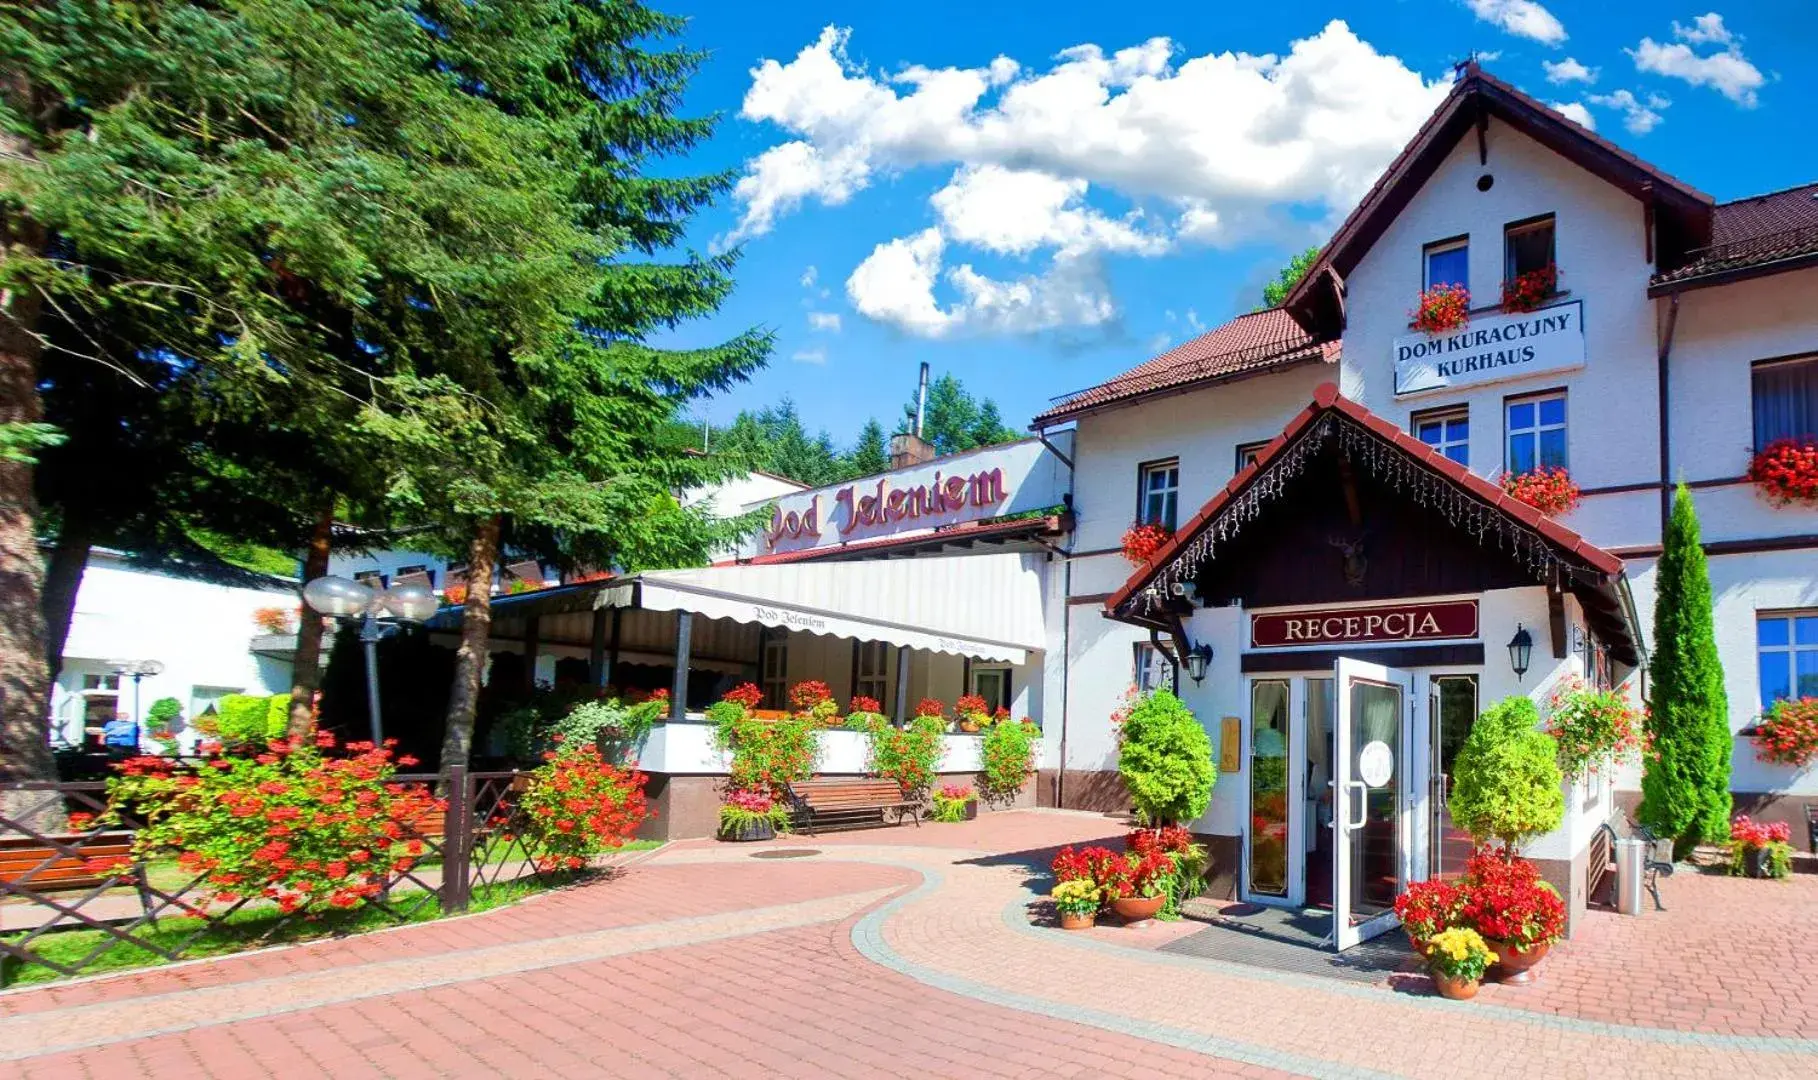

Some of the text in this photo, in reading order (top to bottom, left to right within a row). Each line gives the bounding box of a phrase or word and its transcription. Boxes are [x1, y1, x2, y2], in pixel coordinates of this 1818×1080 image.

[1399, 313, 1571, 361] DOM KURACYJNY
[1438, 345, 1535, 377] KURHAUS
[835, 467, 1008, 535] Jeleniem
[1284, 611, 1441, 639] RECEPCJA
